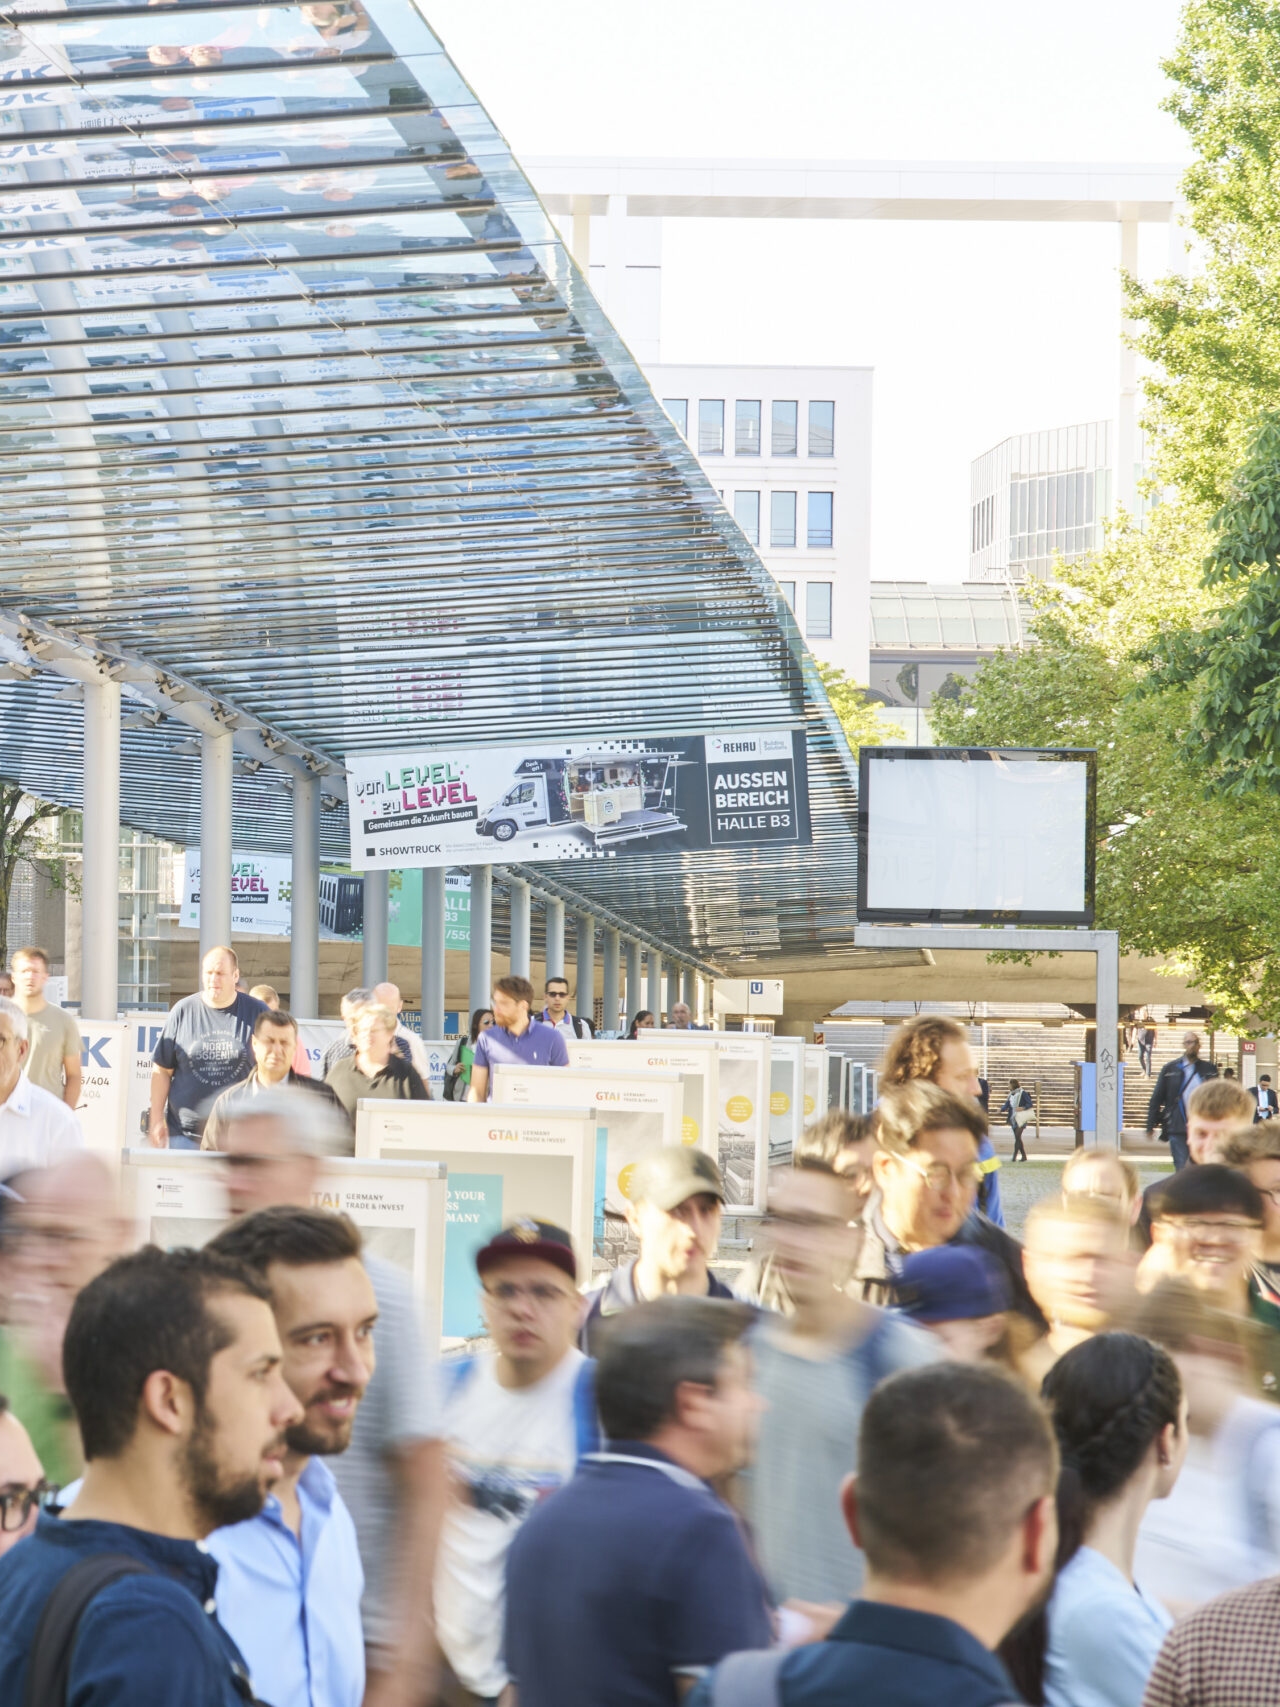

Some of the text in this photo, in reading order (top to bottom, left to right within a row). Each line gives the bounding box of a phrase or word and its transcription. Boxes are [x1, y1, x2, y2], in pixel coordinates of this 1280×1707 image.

[723, 742, 756, 753] REHAU
[385, 763, 461, 791] LEVEL
[714, 771, 788, 790] AUSSEN
[402, 782, 478, 811] LEVEL
[715, 790, 789, 808] BEREICH
[368, 809, 473, 831] Gemeinsam die Zukunft bauen
[717, 814, 791, 831] HALLE B3
[379, 844, 441, 856] SHOWTRUCK
[753, 983, 761, 993] U
[202, 1041, 232, 1051] NORTH
[1244, 1043, 1255, 1051] U2
[596, 1091, 620, 1101] GTAI
[488, 1129, 518, 1141] GTAI
[346, 1193, 384, 1201] GERMANY
[454, 1190, 485, 1201] YOUR
[346, 1202, 369, 1210] TRADE
[378, 1203, 405, 1211] INVEST
